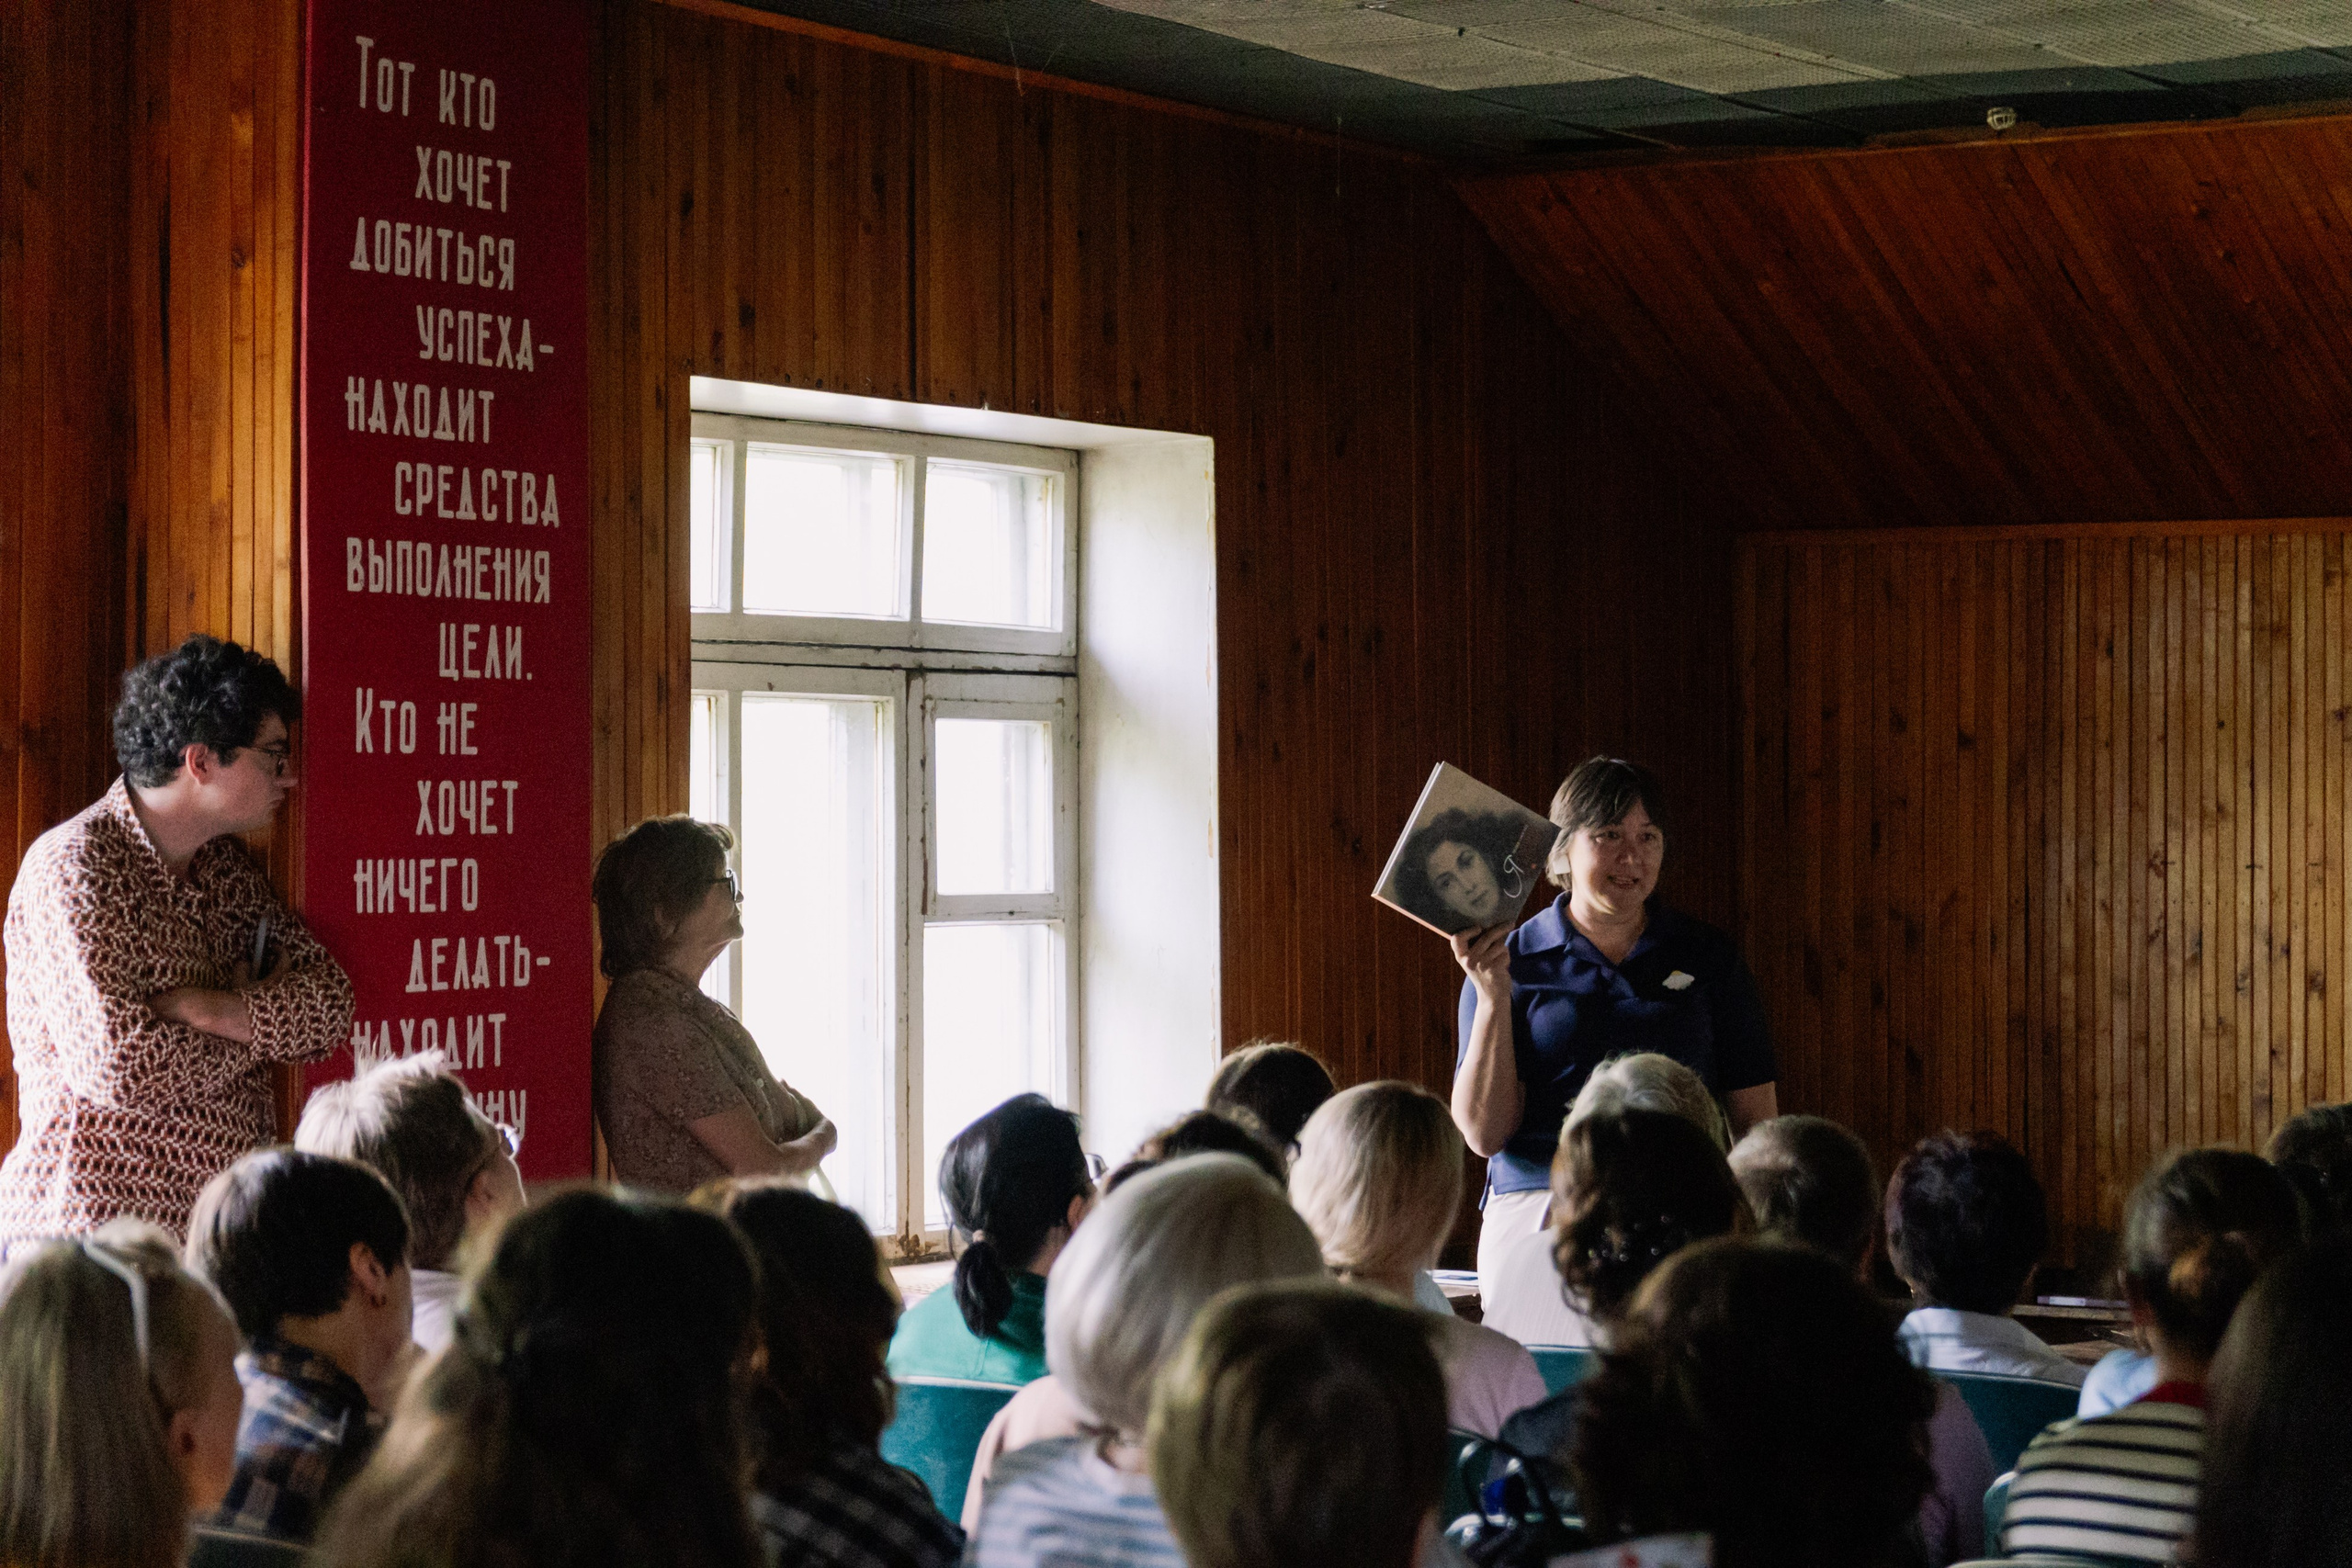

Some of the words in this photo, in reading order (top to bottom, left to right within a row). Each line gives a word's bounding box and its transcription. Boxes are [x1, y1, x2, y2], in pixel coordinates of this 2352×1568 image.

[414, 145, 512, 213] ХОЧЕТ
[349, 216, 515, 291] ДОБИТЬСЯ
[344, 376, 495, 445] НАХОДИТ
[394, 461, 560, 528] СРЕДСТВА
[345, 536, 551, 604] ВЫПОЛНЕНИЯ
[438, 622, 533, 682] ЦЕЛИ.
[435, 702, 479, 756] НЕ
[415, 780, 519, 836] ХОЧЕТ
[353, 858, 480, 914] НИЧЕГО
[404, 935, 551, 993] ДЕЛАТЬ-
